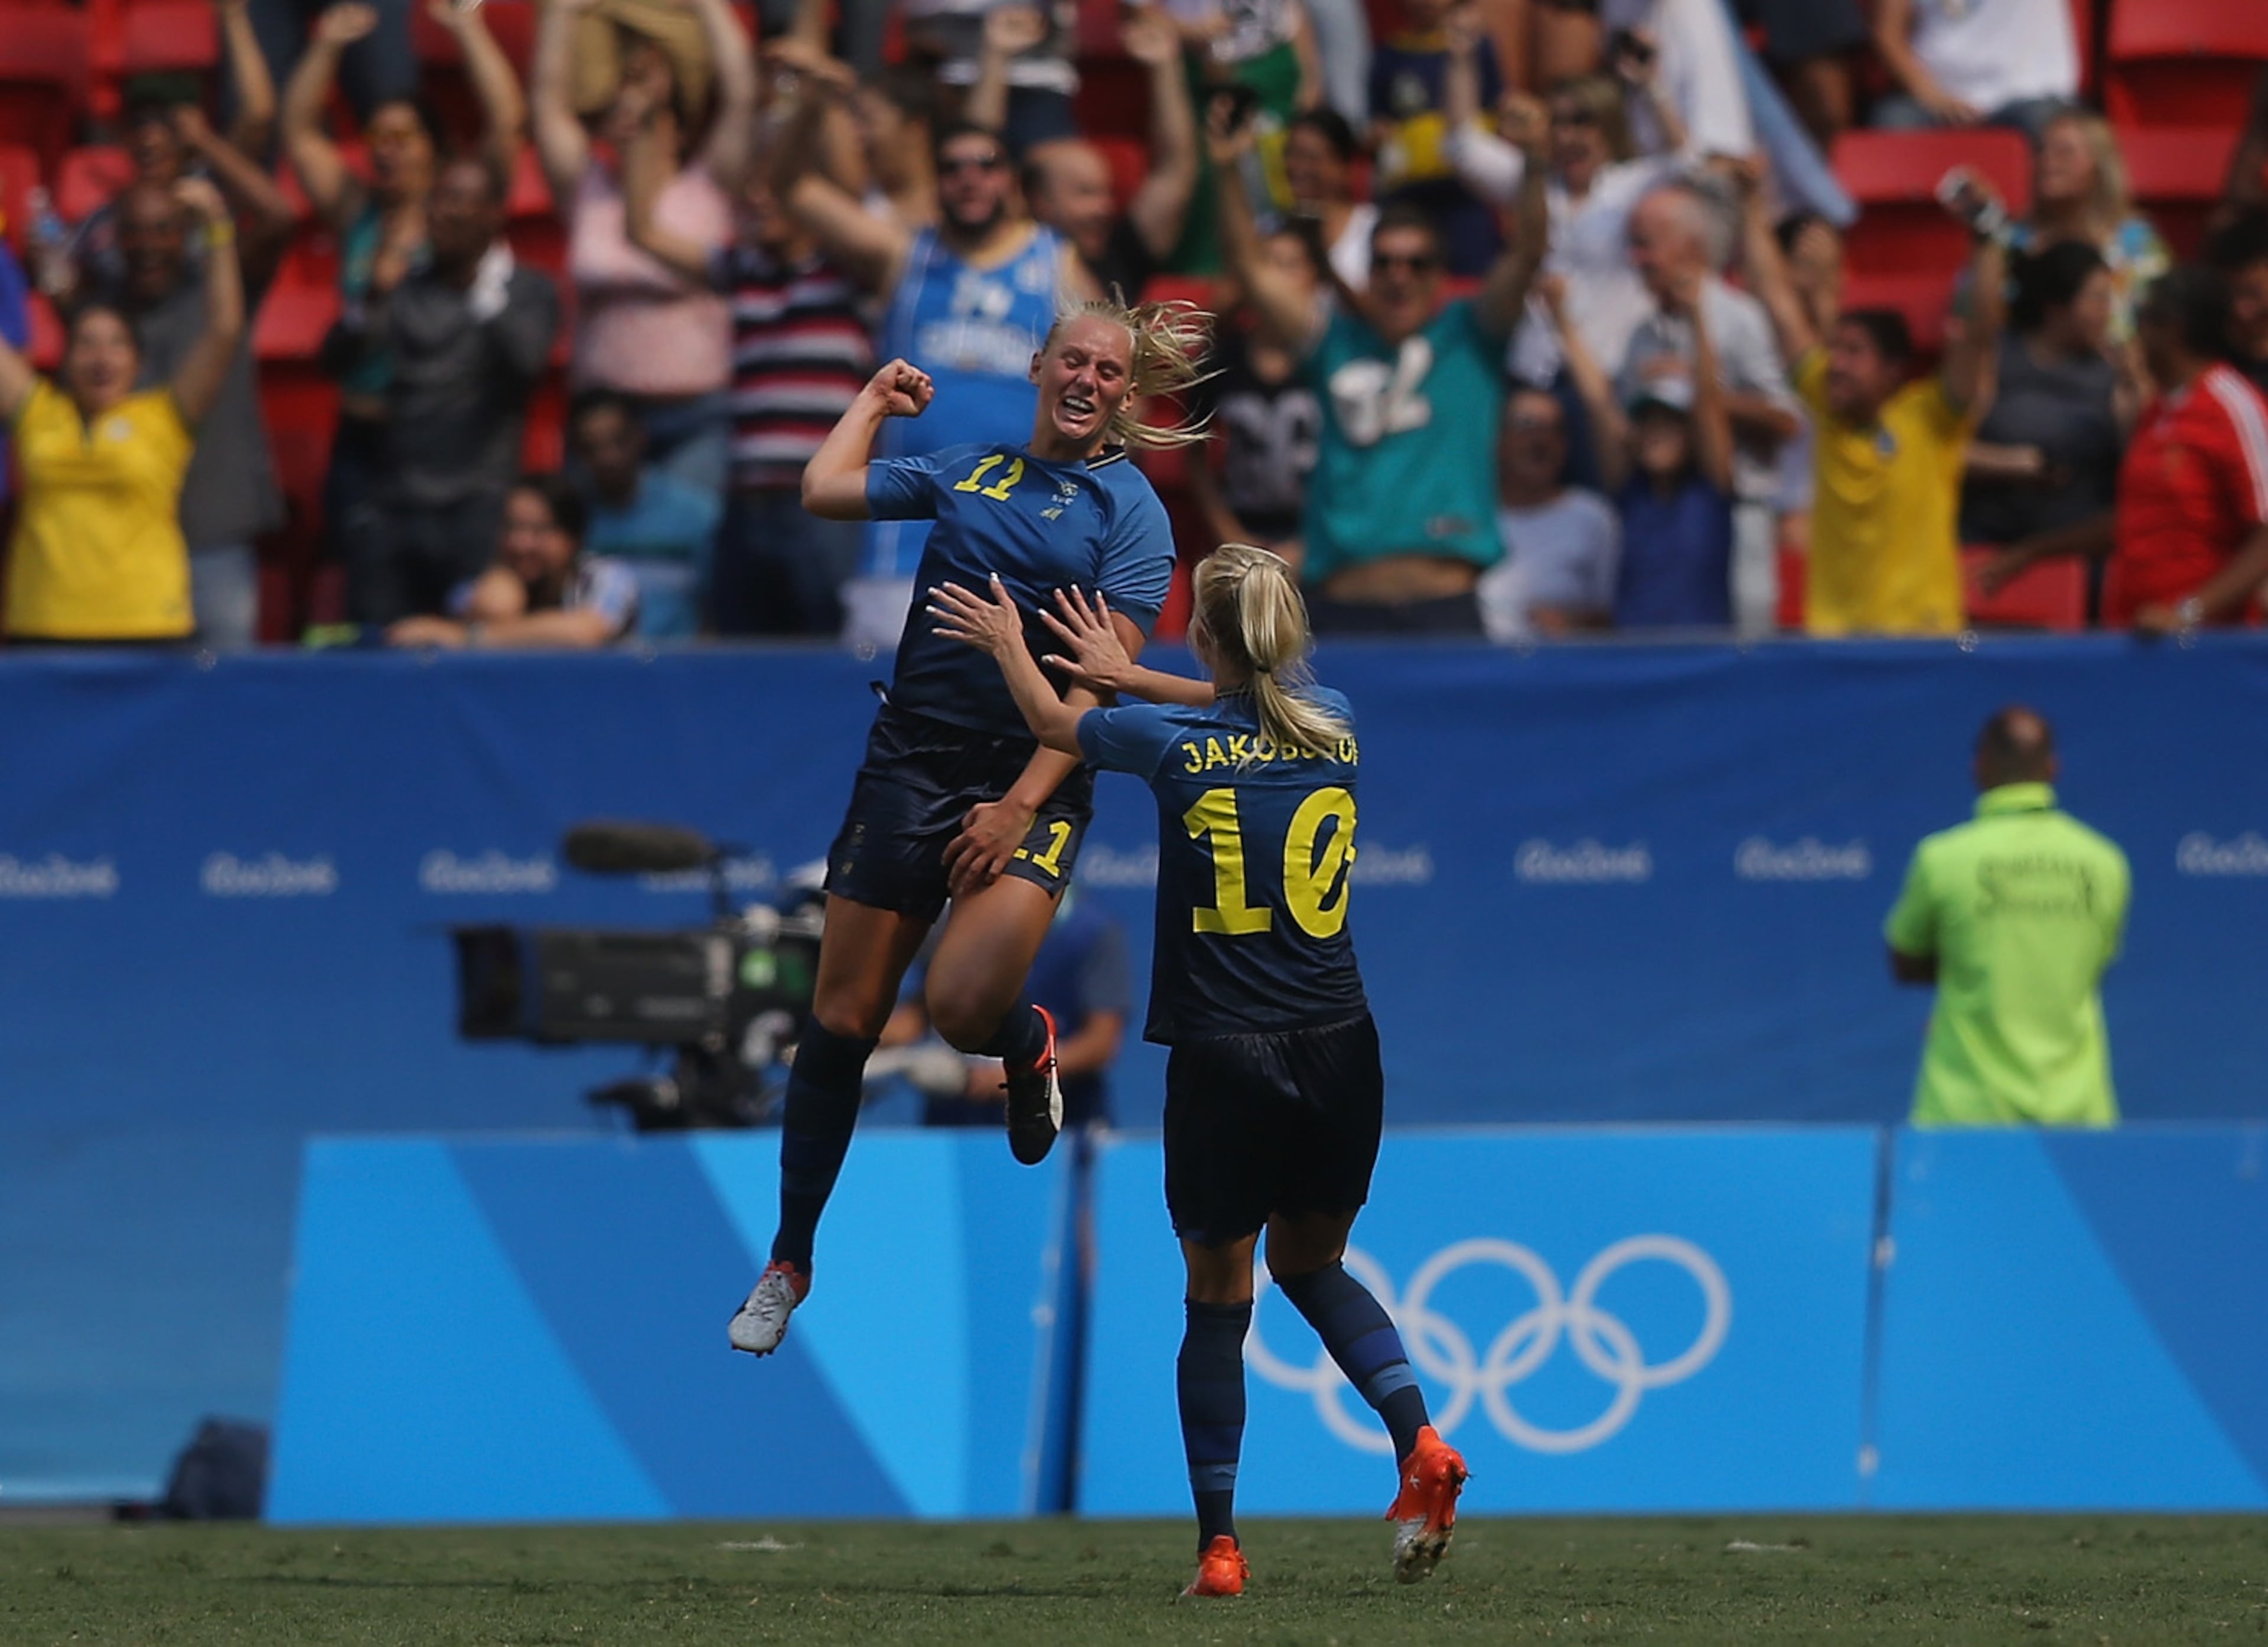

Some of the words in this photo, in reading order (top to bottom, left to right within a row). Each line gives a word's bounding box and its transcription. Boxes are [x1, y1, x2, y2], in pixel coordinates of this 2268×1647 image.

[953, 454, 1025, 502] 11
[1182, 734, 1358, 774] JAKOBO
[1014, 820, 1071, 878] 1
[1182, 786, 1357, 938] 10
